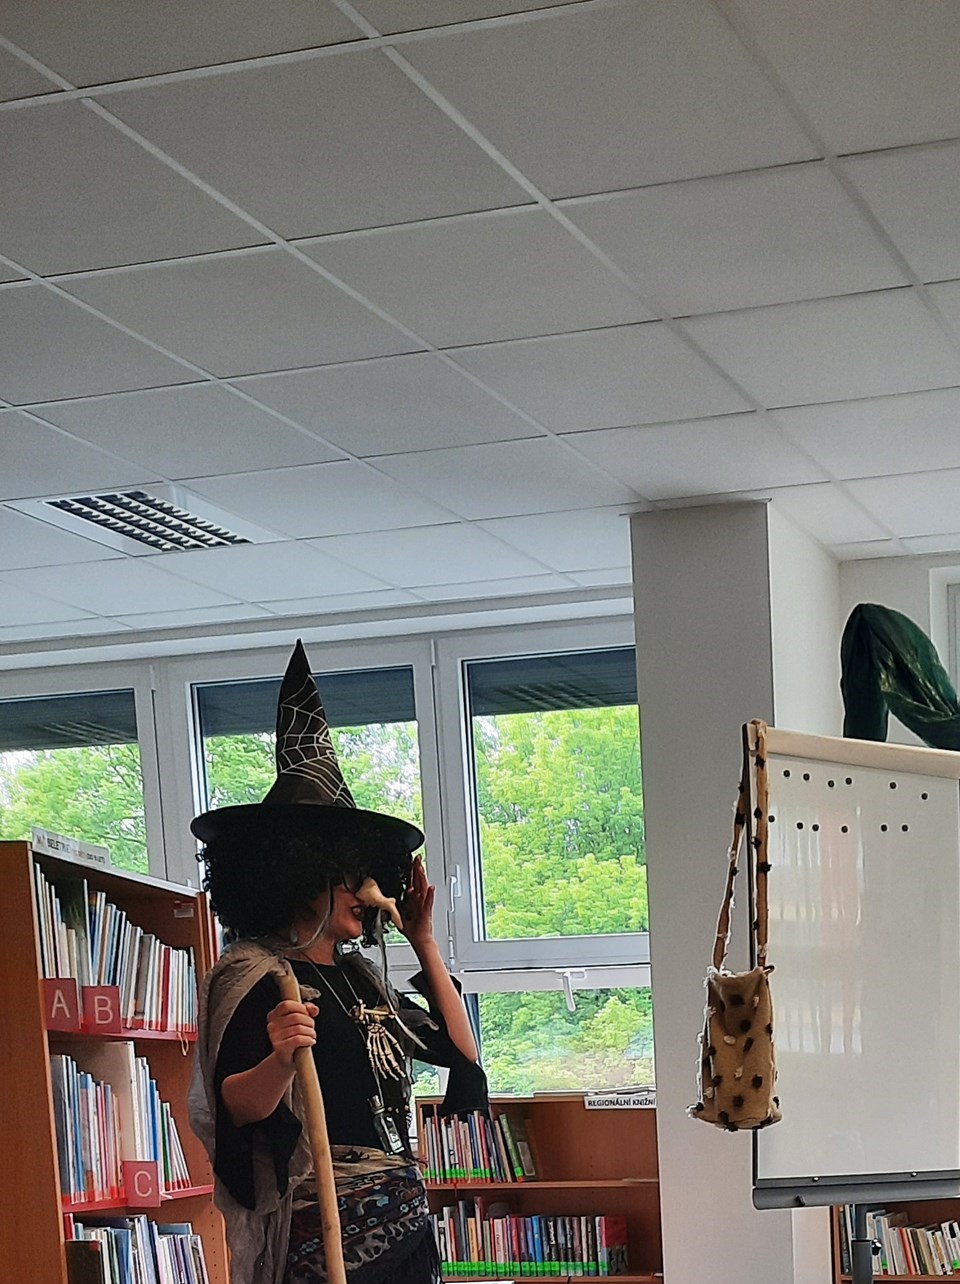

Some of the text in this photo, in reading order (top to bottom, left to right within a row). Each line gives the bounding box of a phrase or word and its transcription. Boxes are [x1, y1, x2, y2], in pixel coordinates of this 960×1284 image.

[51, 989, 70, 1018] A
[94, 996, 113, 1024] B
[587, 1098, 631, 1107] REGIONÁLNÍ
[134, 1170, 151, 1197] C
